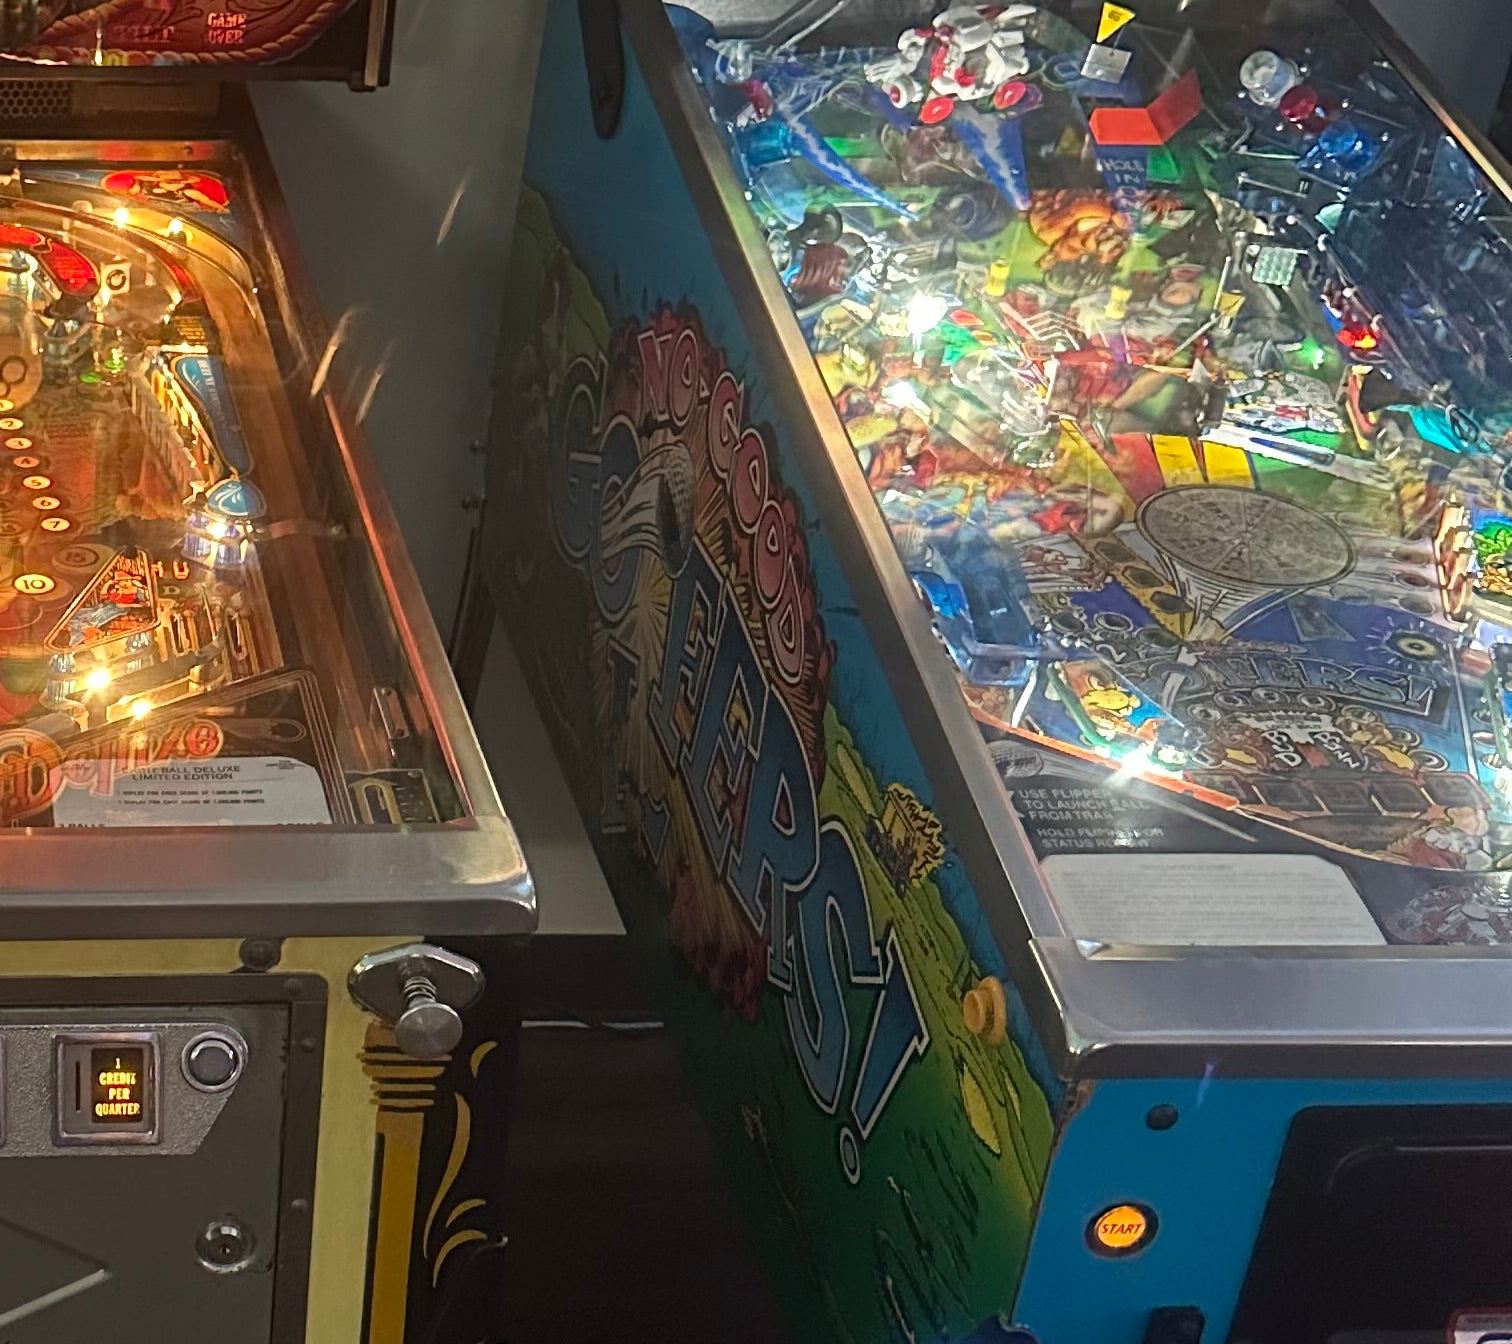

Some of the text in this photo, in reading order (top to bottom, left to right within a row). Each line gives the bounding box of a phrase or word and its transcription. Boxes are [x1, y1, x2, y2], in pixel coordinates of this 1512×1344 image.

[208, 12, 248, 28] GAME
[208, 29, 245, 44] OVER
[638, 329, 804, 684] NO GOOD
[193, 765, 241, 773] DELUXE
[132, 772, 234, 781] LIMITED EDITION
[1018, 788, 1113, 801] USE FLIPPER
[1023, 799, 1045, 810] TO
[1047, 799, 1107, 810] LAUNCH
[1028, 810, 1072, 821] FROM
[1041, 838, 1093, 849] STATUS
[115, 1057, 121, 1070] 1
[98, 1071, 137, 1086] CREDIT
[108, 1087, 131, 1101] PER
[94, 1102, 141, 1117] QUARTER
[1100, 1222, 1144, 1237] START
